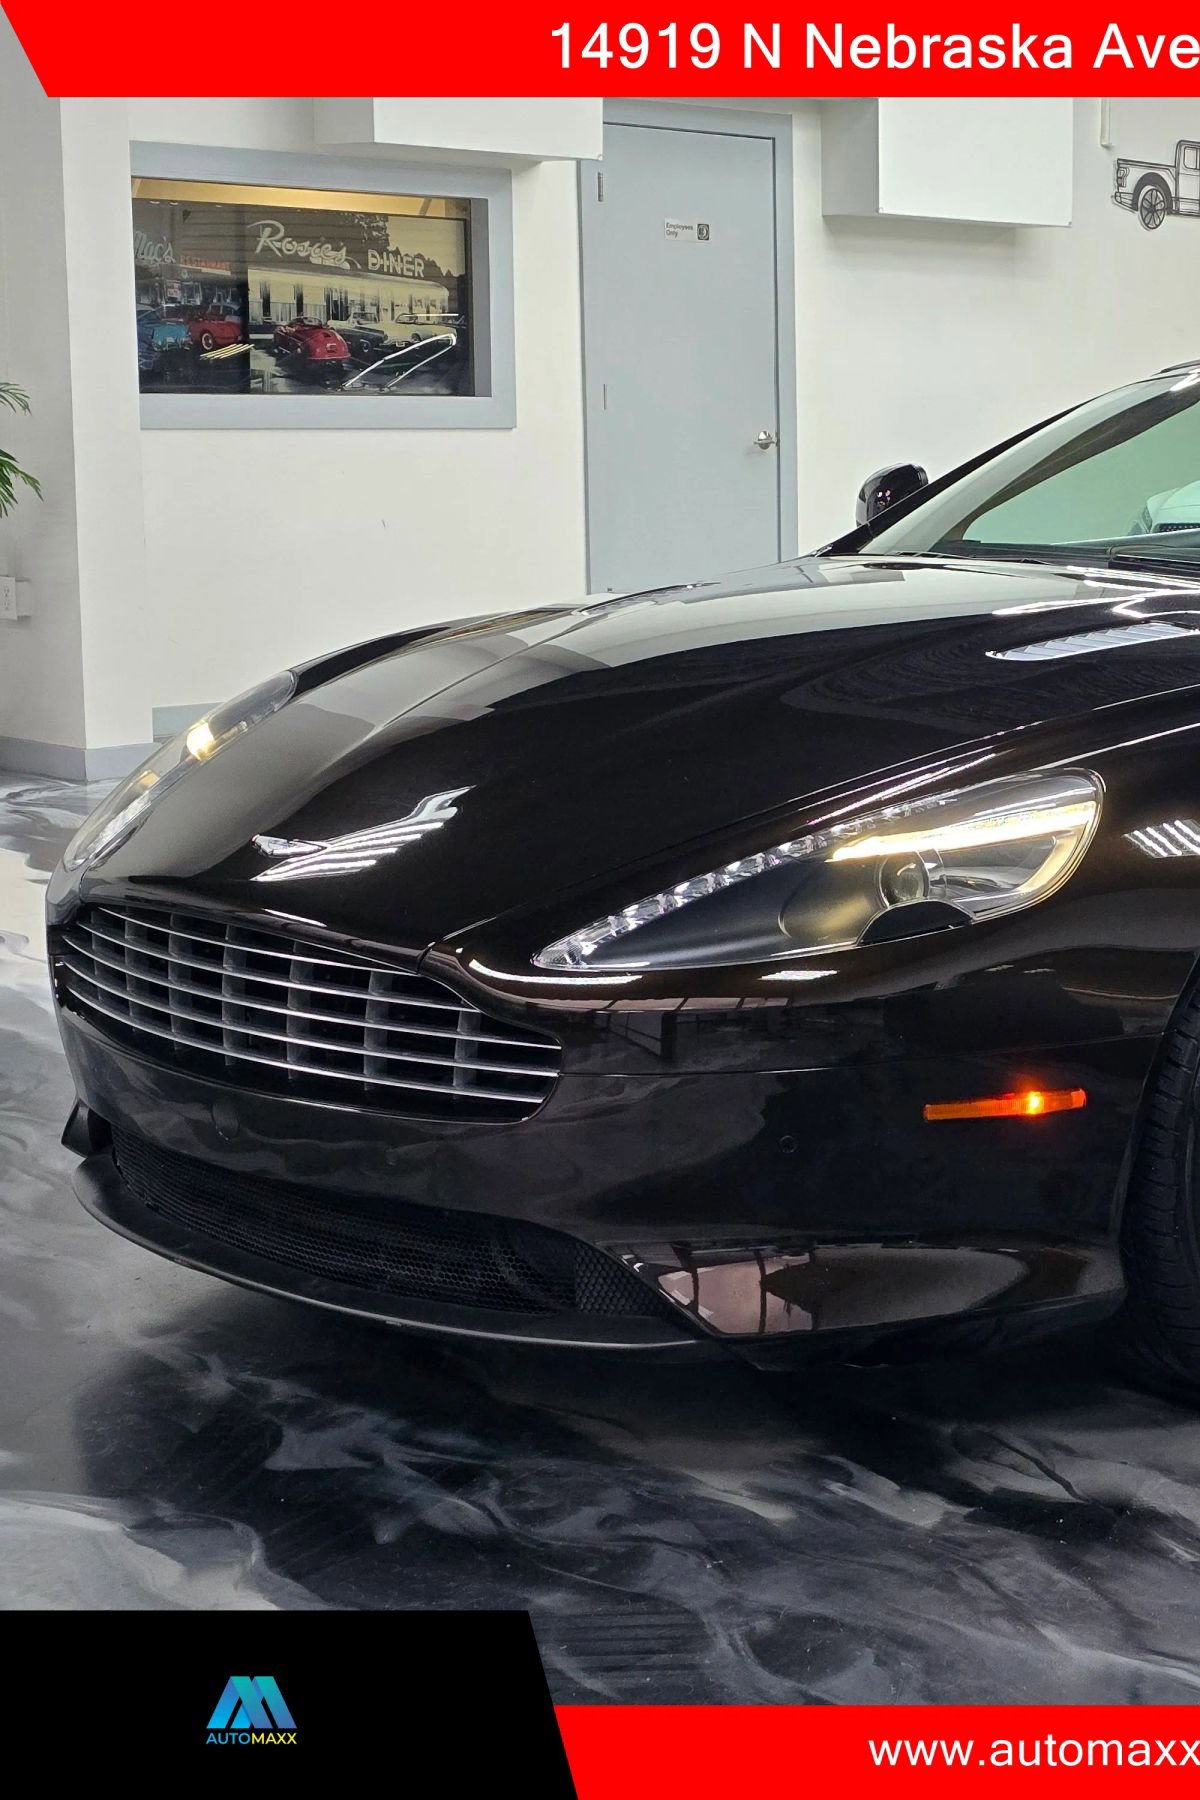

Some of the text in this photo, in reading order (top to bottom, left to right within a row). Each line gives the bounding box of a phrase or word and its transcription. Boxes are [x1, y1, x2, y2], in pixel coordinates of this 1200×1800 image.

[665, 222, 694, 231] Employees
[665, 229, 679, 239] Only
[367, 249, 425, 278] DINER
